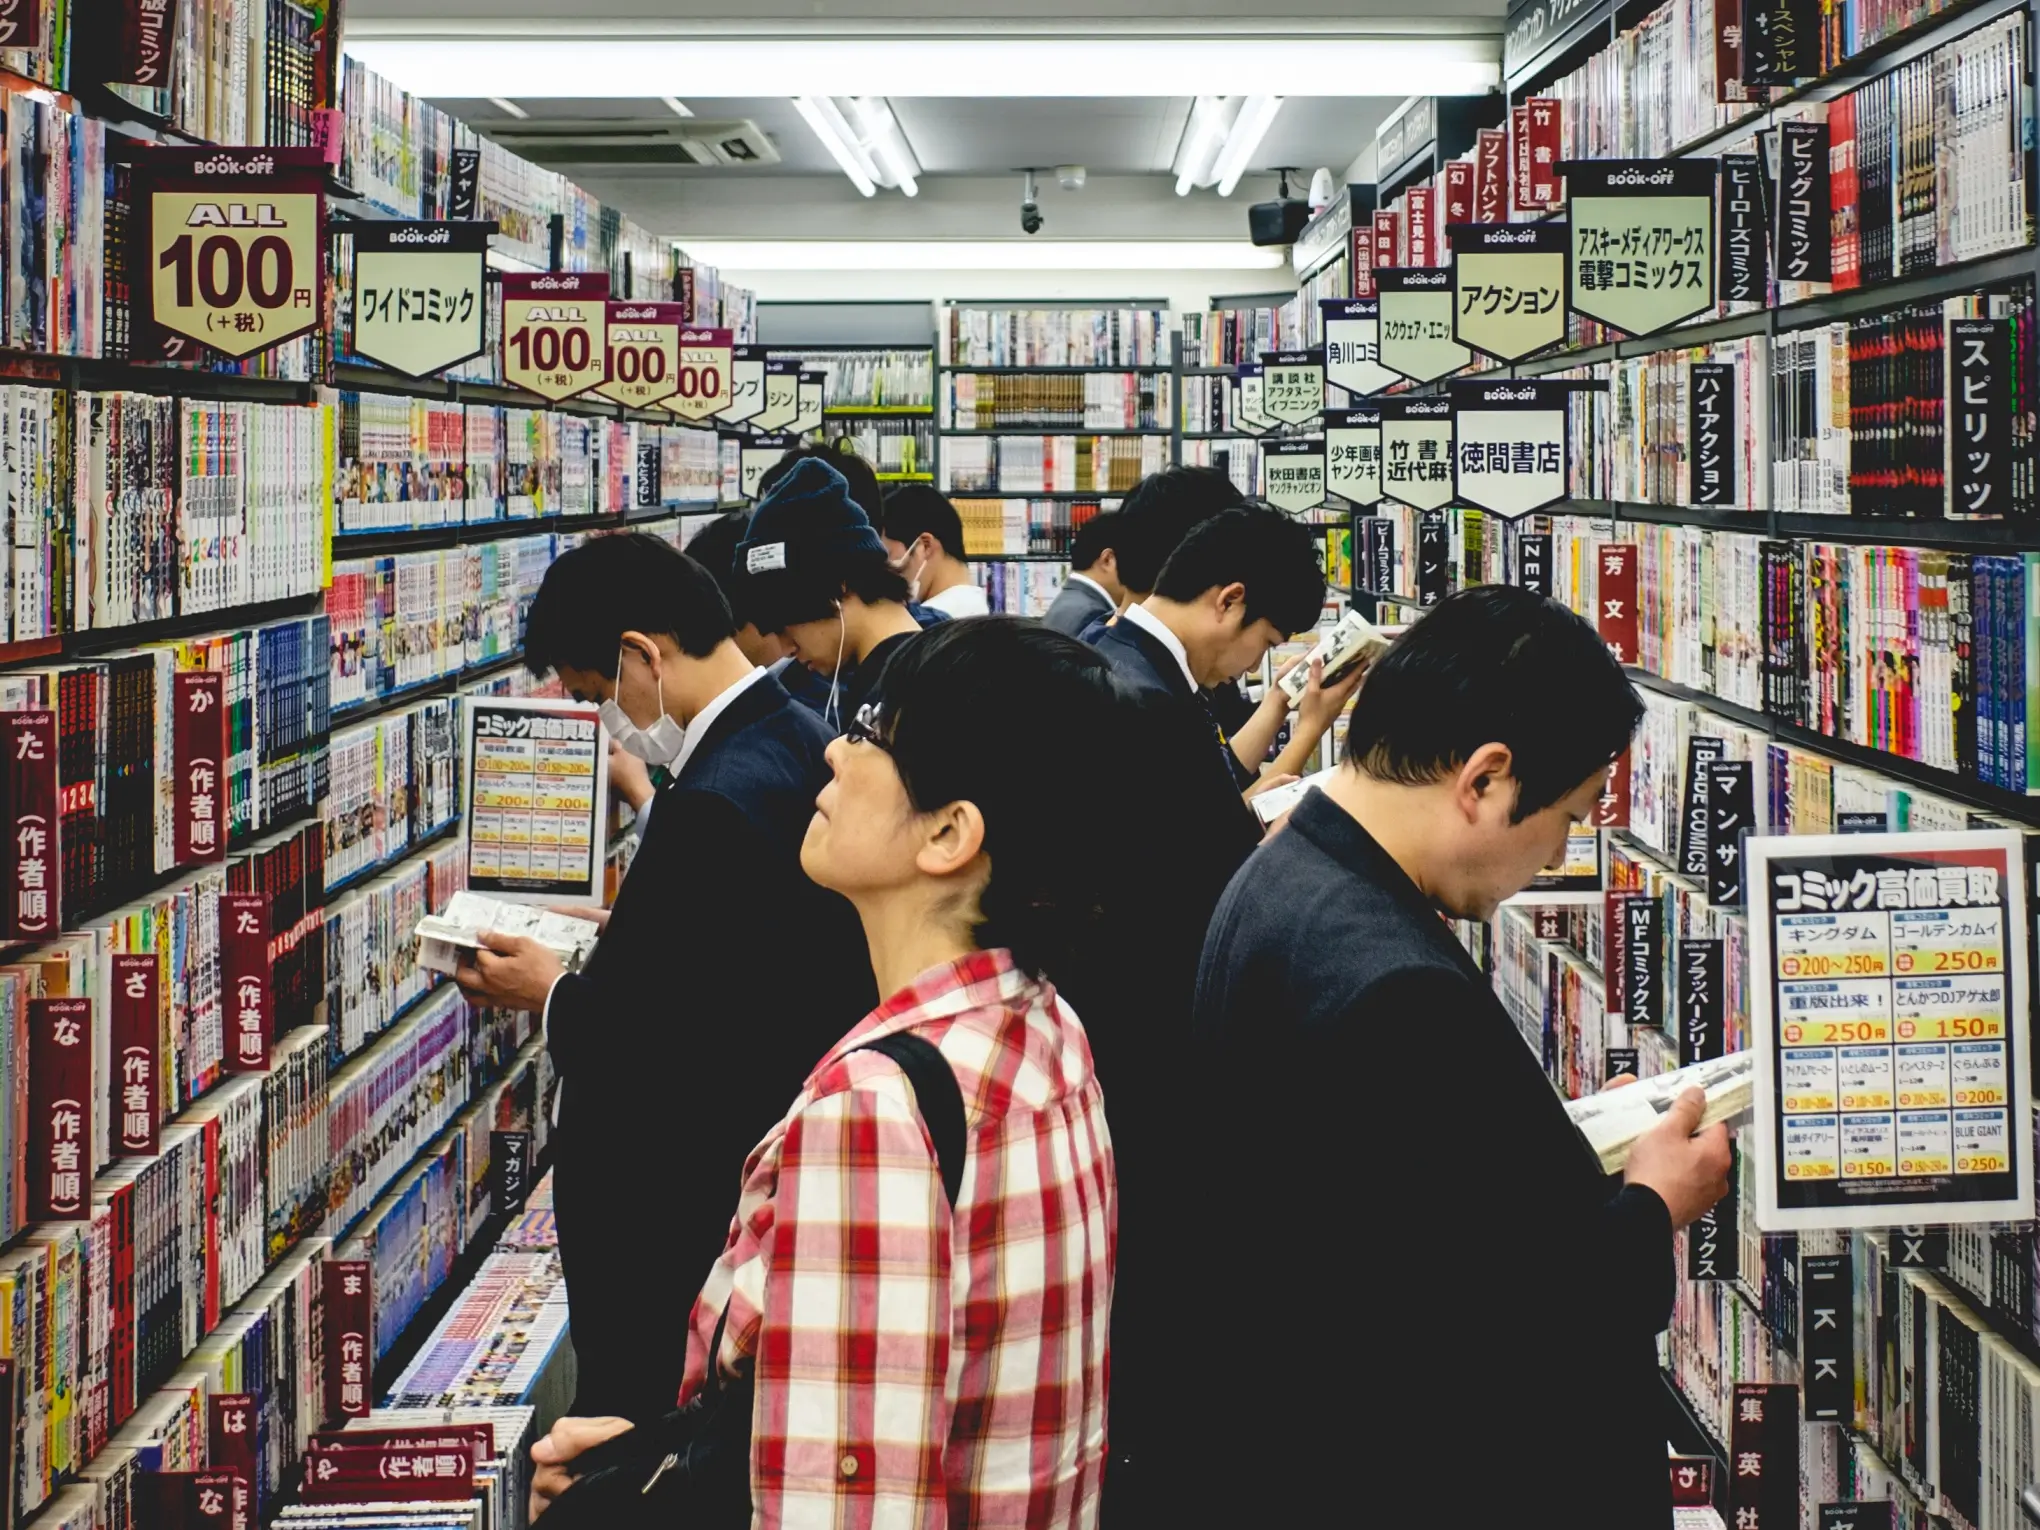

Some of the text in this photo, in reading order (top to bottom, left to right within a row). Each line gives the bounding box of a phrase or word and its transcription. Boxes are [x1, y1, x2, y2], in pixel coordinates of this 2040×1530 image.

[1533, 109, 1552, 201] 竹書房
[454, 158, 477, 219] ジャン
[1449, 171, 1466, 217] 幻冬
[1482, 141, 1501, 223] ソフトバンク
[187, 204, 287, 227] ALL
[1787, 138, 1812, 279] ビッグコミック
[1411, 196, 1426, 267] 富士見書房
[1578, 227, 1704, 257] アスキーメディアワークス
[1729, 169, 1752, 299] ヒーローズコミック
[1578, 260, 1703, 292] 電撃コミックス
[363, 288, 475, 324] ワイドコミック
[526, 307, 587, 323] ALL
[1461, 285, 1560, 316] アクション
[613, 329, 663, 342] ALL
[1697, 378, 1721, 502] ハイアクション
[1960, 340, 1993, 510] スピリッツ
[1389, 440, 1452, 462] 竹書
[1460, 441, 1561, 475] 徳間書店
[1268, 467, 1321, 482] 秋田書店
[1331, 464, 1380, 483] ヤングキ
[1387, 461, 1452, 482] 近代麻
[189, 689, 214, 713] か
[476, 714, 596, 740] コミック高価買取
[16, 731, 45, 761] た
[1716, 776, 1740, 903] マンサン
[1775, 867, 2001, 911] コミック高価買取
[236, 911, 260, 934] た
[1788, 927, 1878, 942] キングダム
[1893, 922, 1999, 939] ゴールデンカムイ
[1631, 909, 1651, 1020] MFコミックス
[124, 971, 148, 999] さ
[53, 1017, 81, 1046] な
[1955, 1126, 1975, 1137] BLUE
[1976, 1125, 2002, 1137] GIANT
[504, 1141, 521, 1210] マガジン
[222, 1411, 247, 1434] は
[1736, 1398, 1764, 1530] 集英社
[199, 1489, 223, 1515] な
